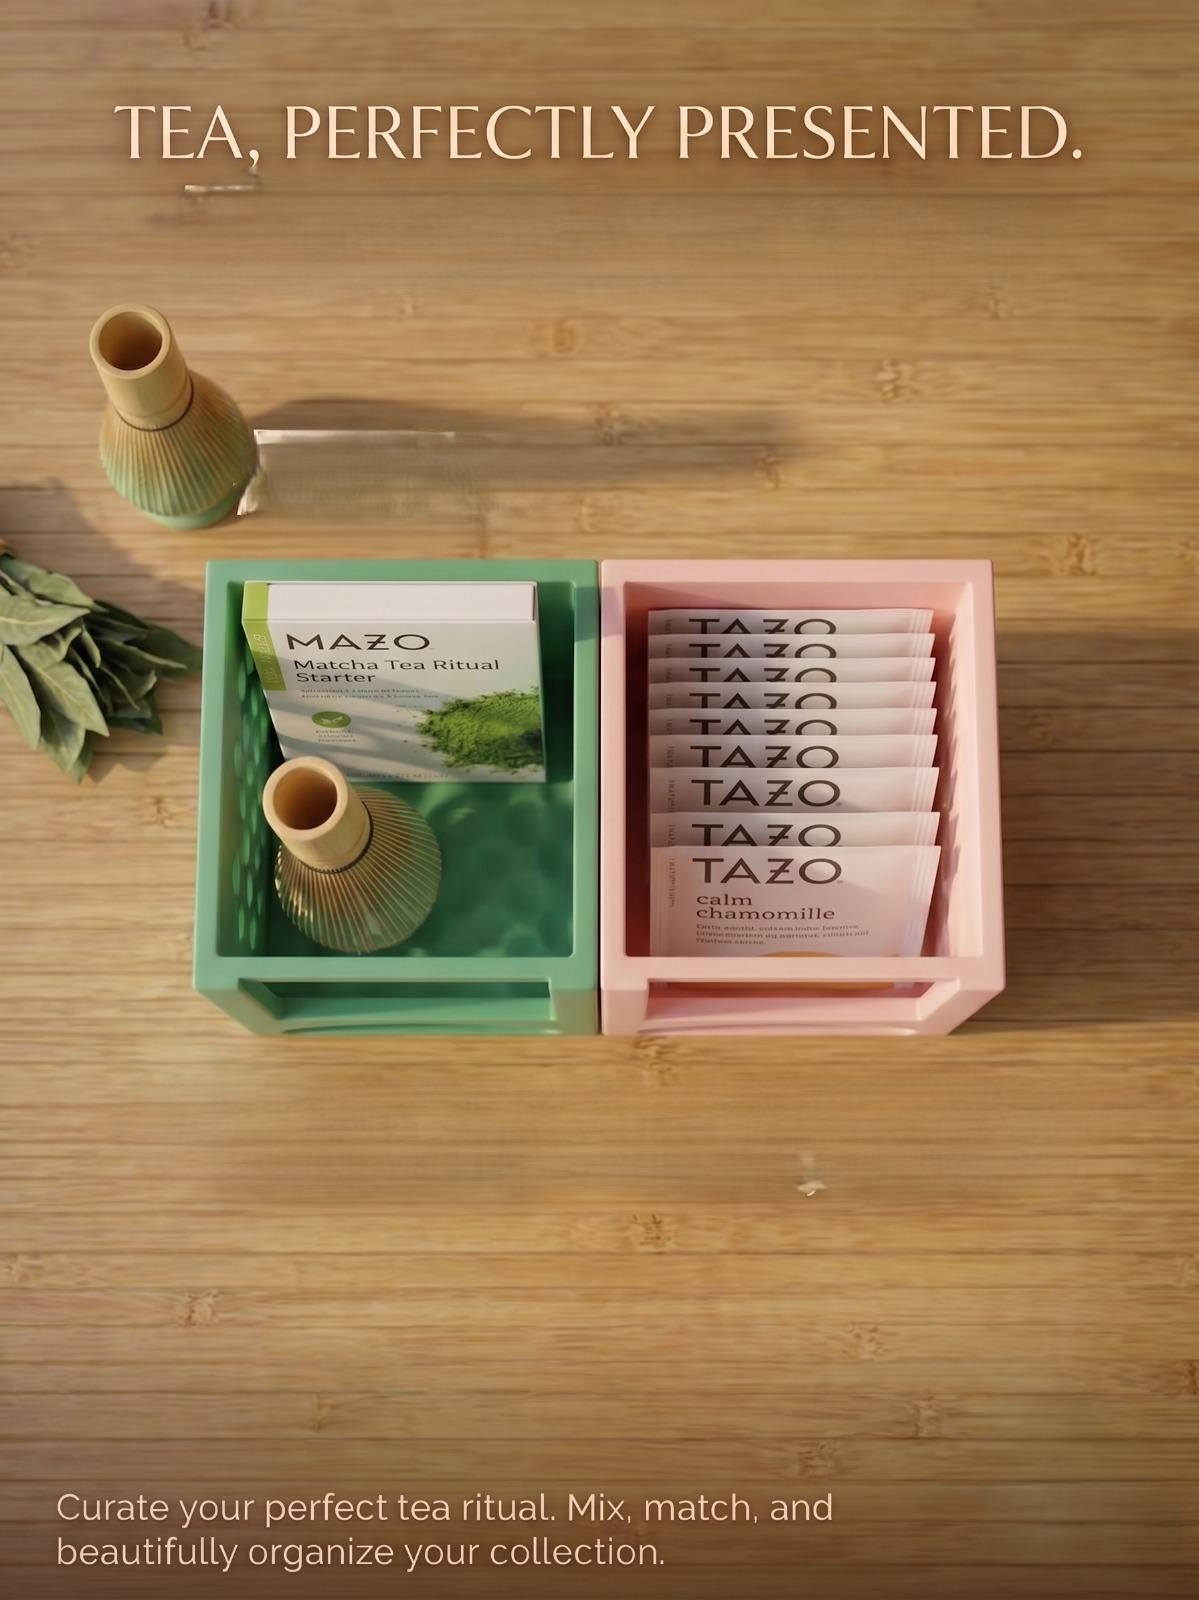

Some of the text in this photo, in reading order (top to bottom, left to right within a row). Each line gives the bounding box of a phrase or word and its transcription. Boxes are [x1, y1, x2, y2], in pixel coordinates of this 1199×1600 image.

[293, 658, 500, 670] Matcha Tea Ritual
[296, 672, 376, 683] Starter
[690, 745, 839, 768] TAZO
[691, 779, 840, 807] TAZO
[692, 824, 841, 847] TAZO
[692, 857, 842, 885] TAZO
[696, 894, 753, 906] calm
[696, 908, 836, 921] chamomille
